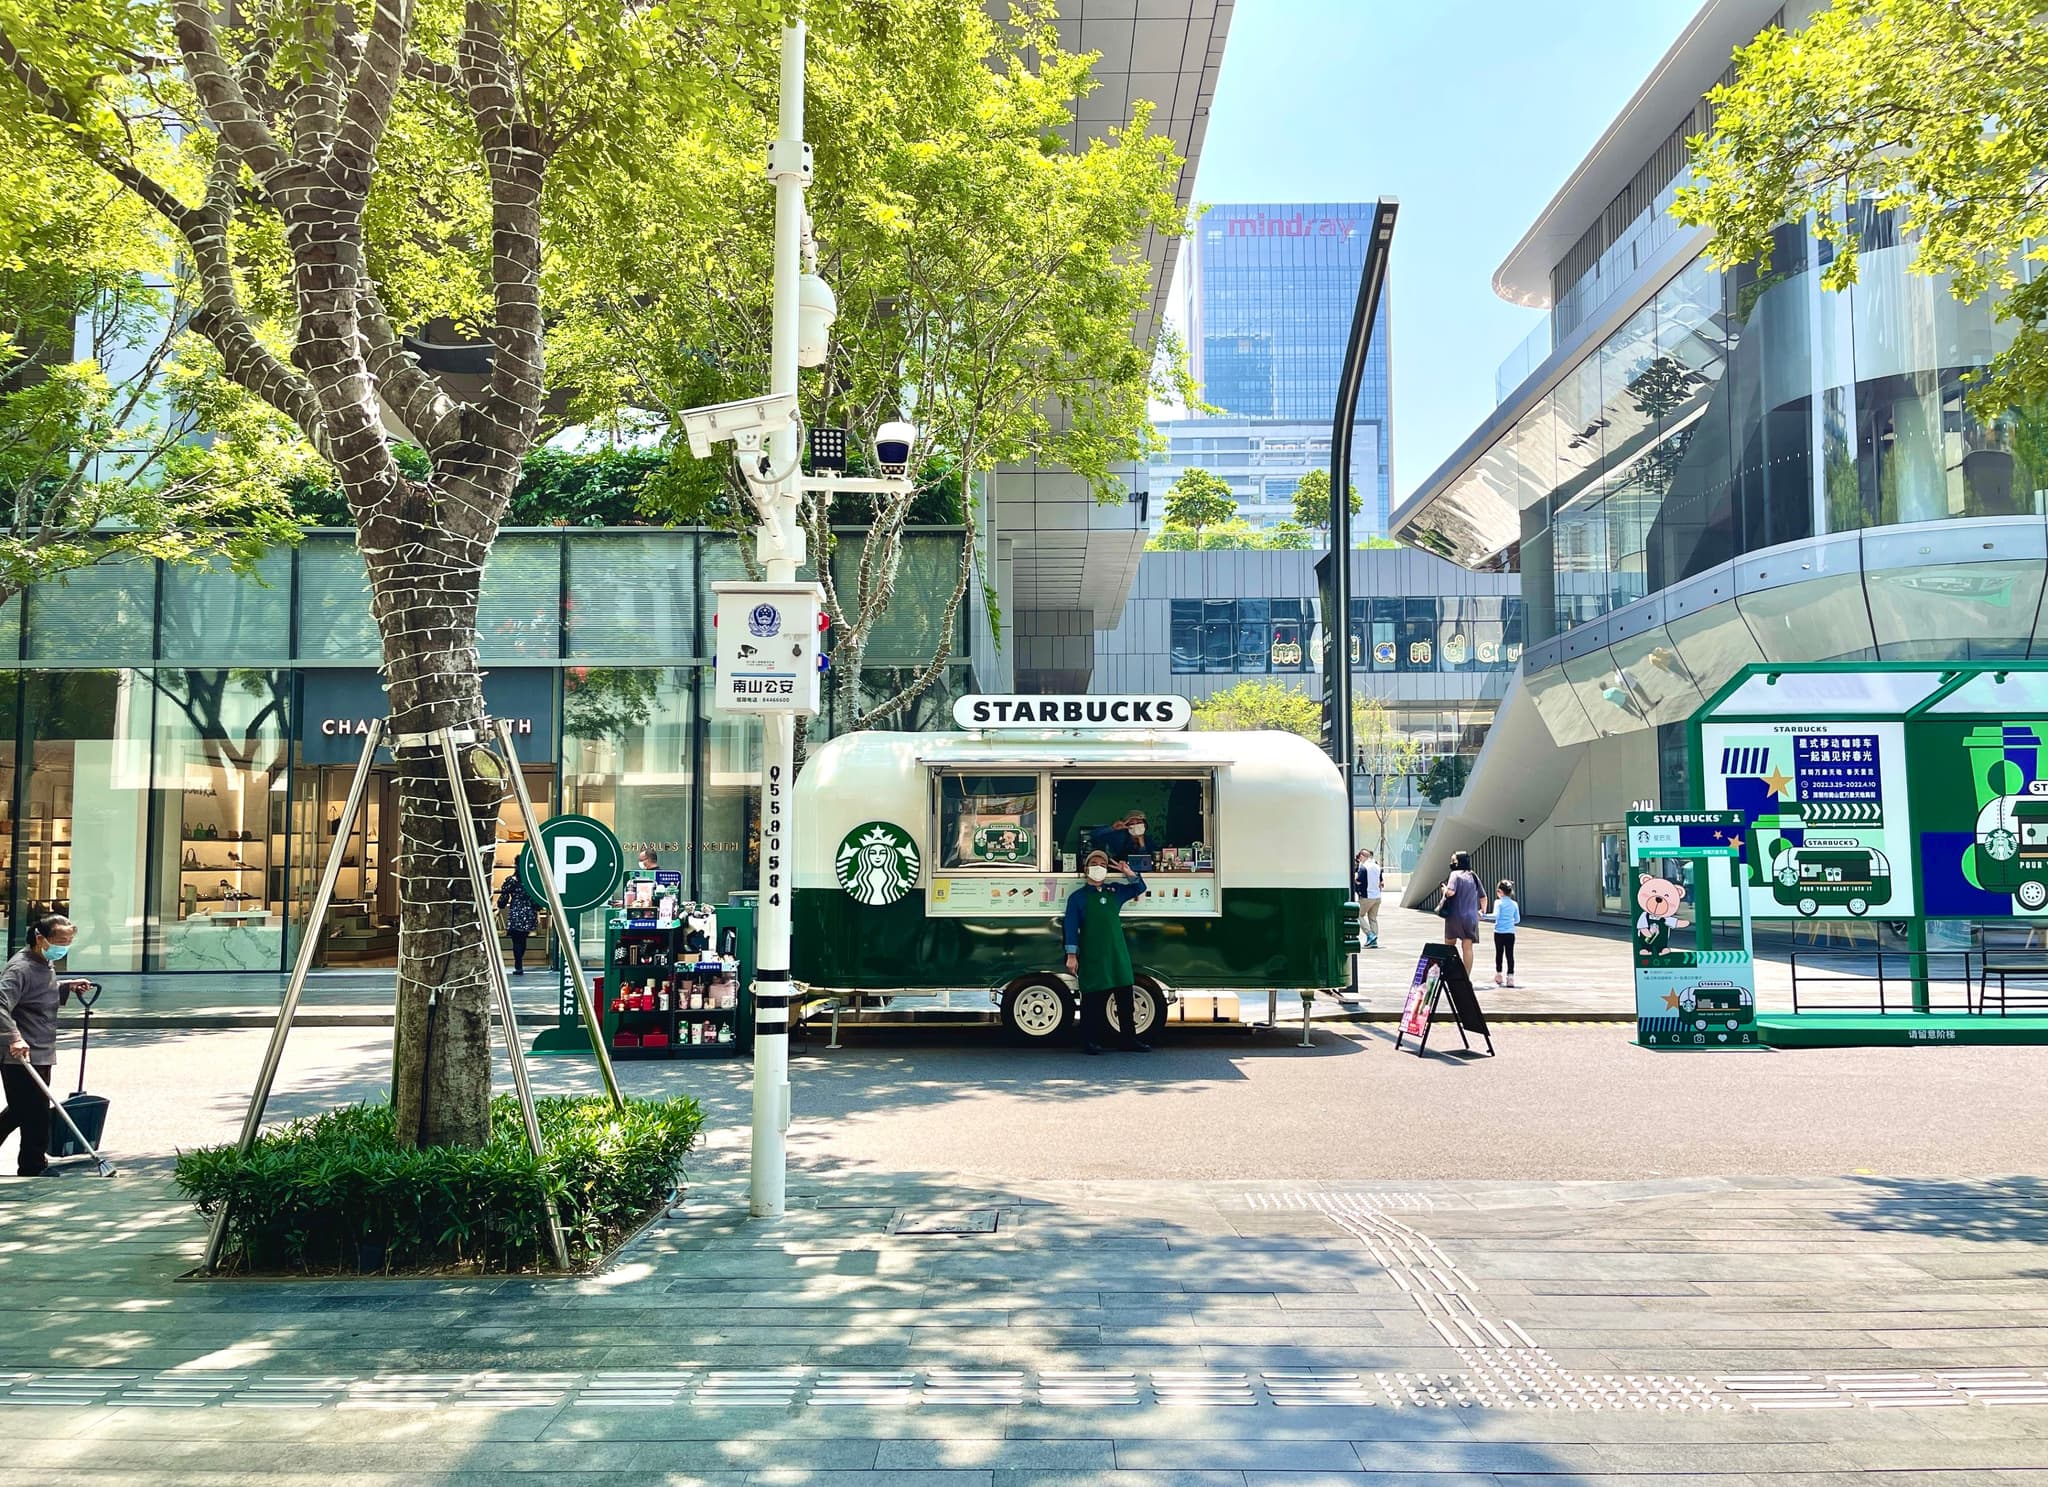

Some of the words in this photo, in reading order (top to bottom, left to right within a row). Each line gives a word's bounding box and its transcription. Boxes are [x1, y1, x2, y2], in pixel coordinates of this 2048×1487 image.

[1228, 212, 1355, 244] mindray
[733, 680, 793, 694] 南山公安
[973, 701, 1173, 722] STARBUCKS
[1799, 738, 1872, 749] 星式移动咖啡车
[1799, 751, 1873, 762] 一起遇见好春光
[1653, 814, 1720, 823] STARBUCKS
[623, 841, 680, 852] CHARLES
[703, 841, 739, 852] KEITH
[553, 836, 598, 894] P
[2019, 861, 2042, 869] POUR
[1908, 1030, 1956, 1039] 请留意阶梯
